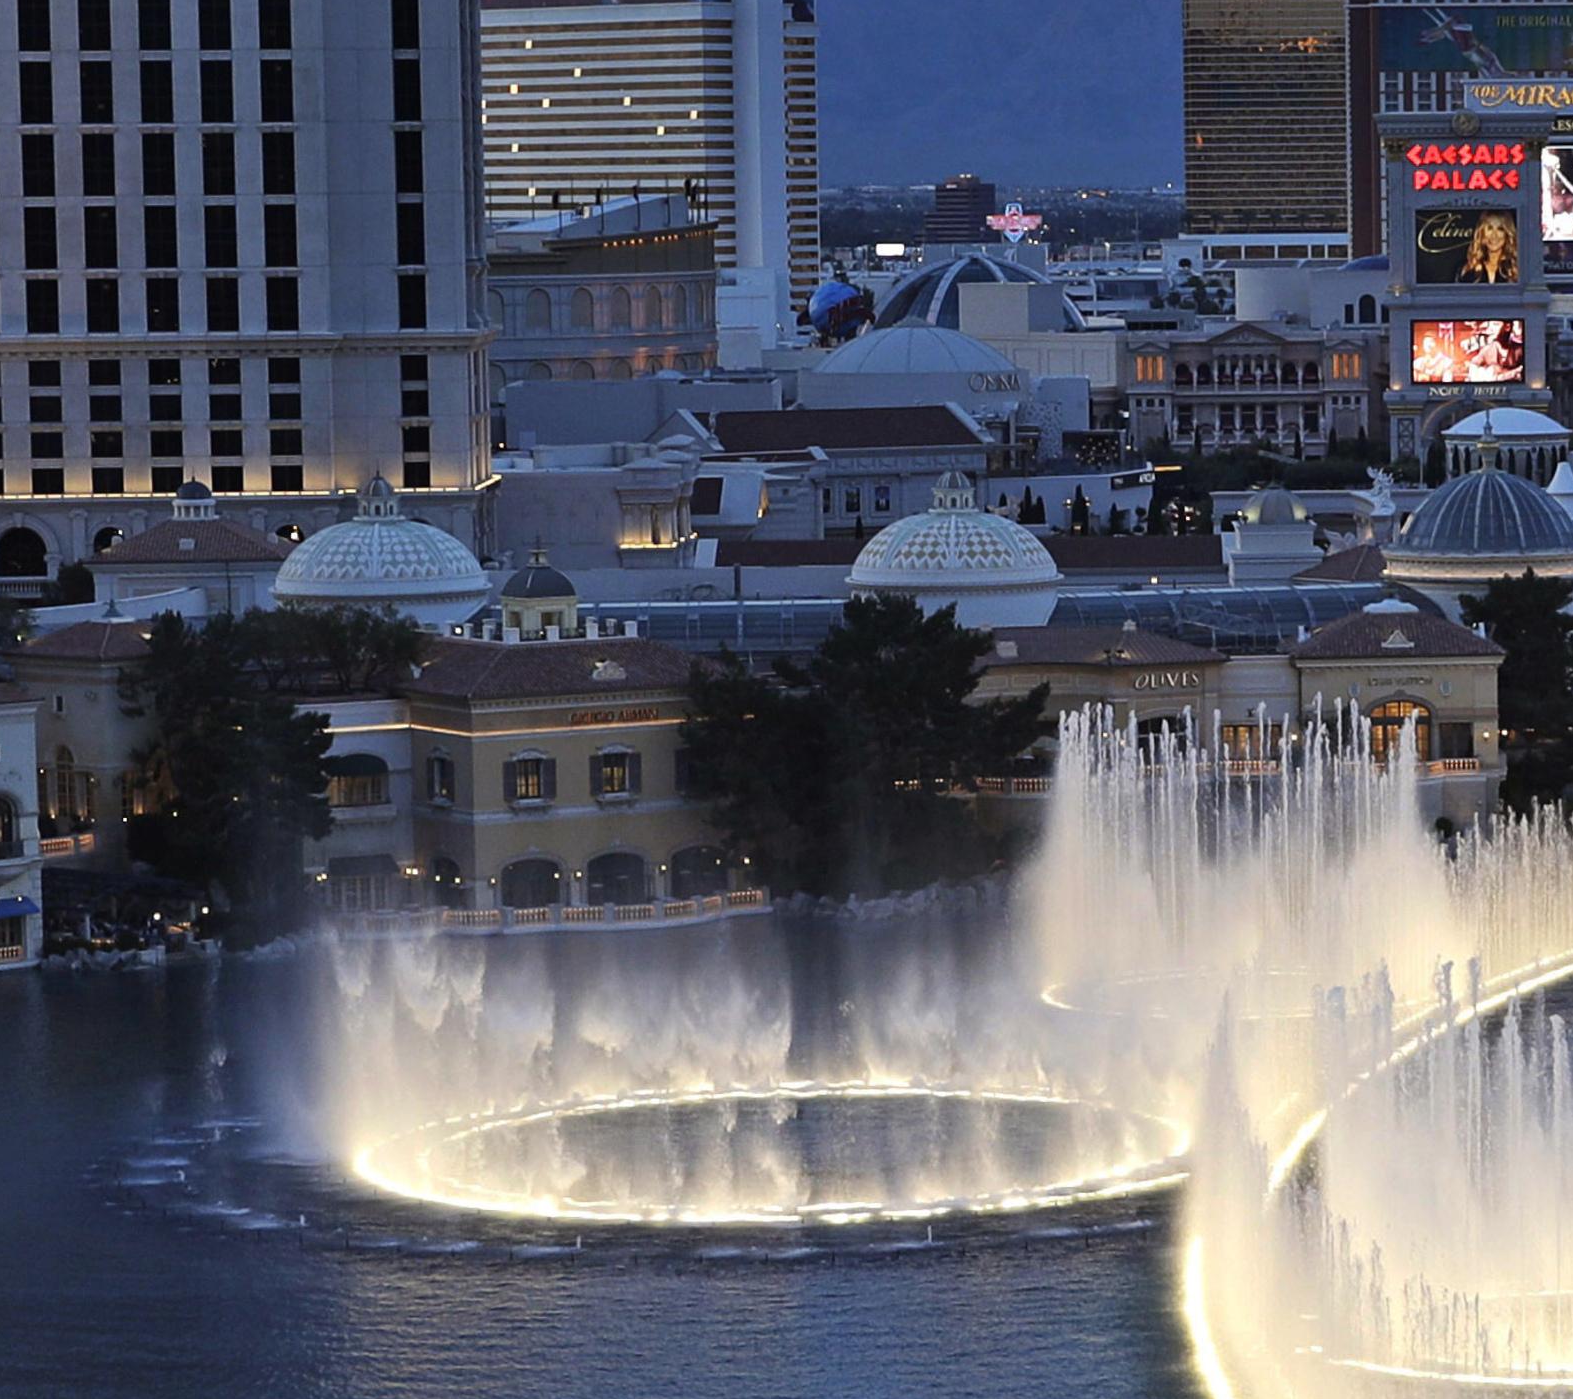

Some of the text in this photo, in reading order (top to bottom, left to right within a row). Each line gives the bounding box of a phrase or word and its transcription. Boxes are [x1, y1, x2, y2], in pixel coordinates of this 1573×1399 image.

[1496, 15, 1516, 27] THE
[1406, 143, 1525, 166] CAESARS
[1413, 169, 1520, 192] PALACE
[1134, 671, 1200, 690] OLIVES
